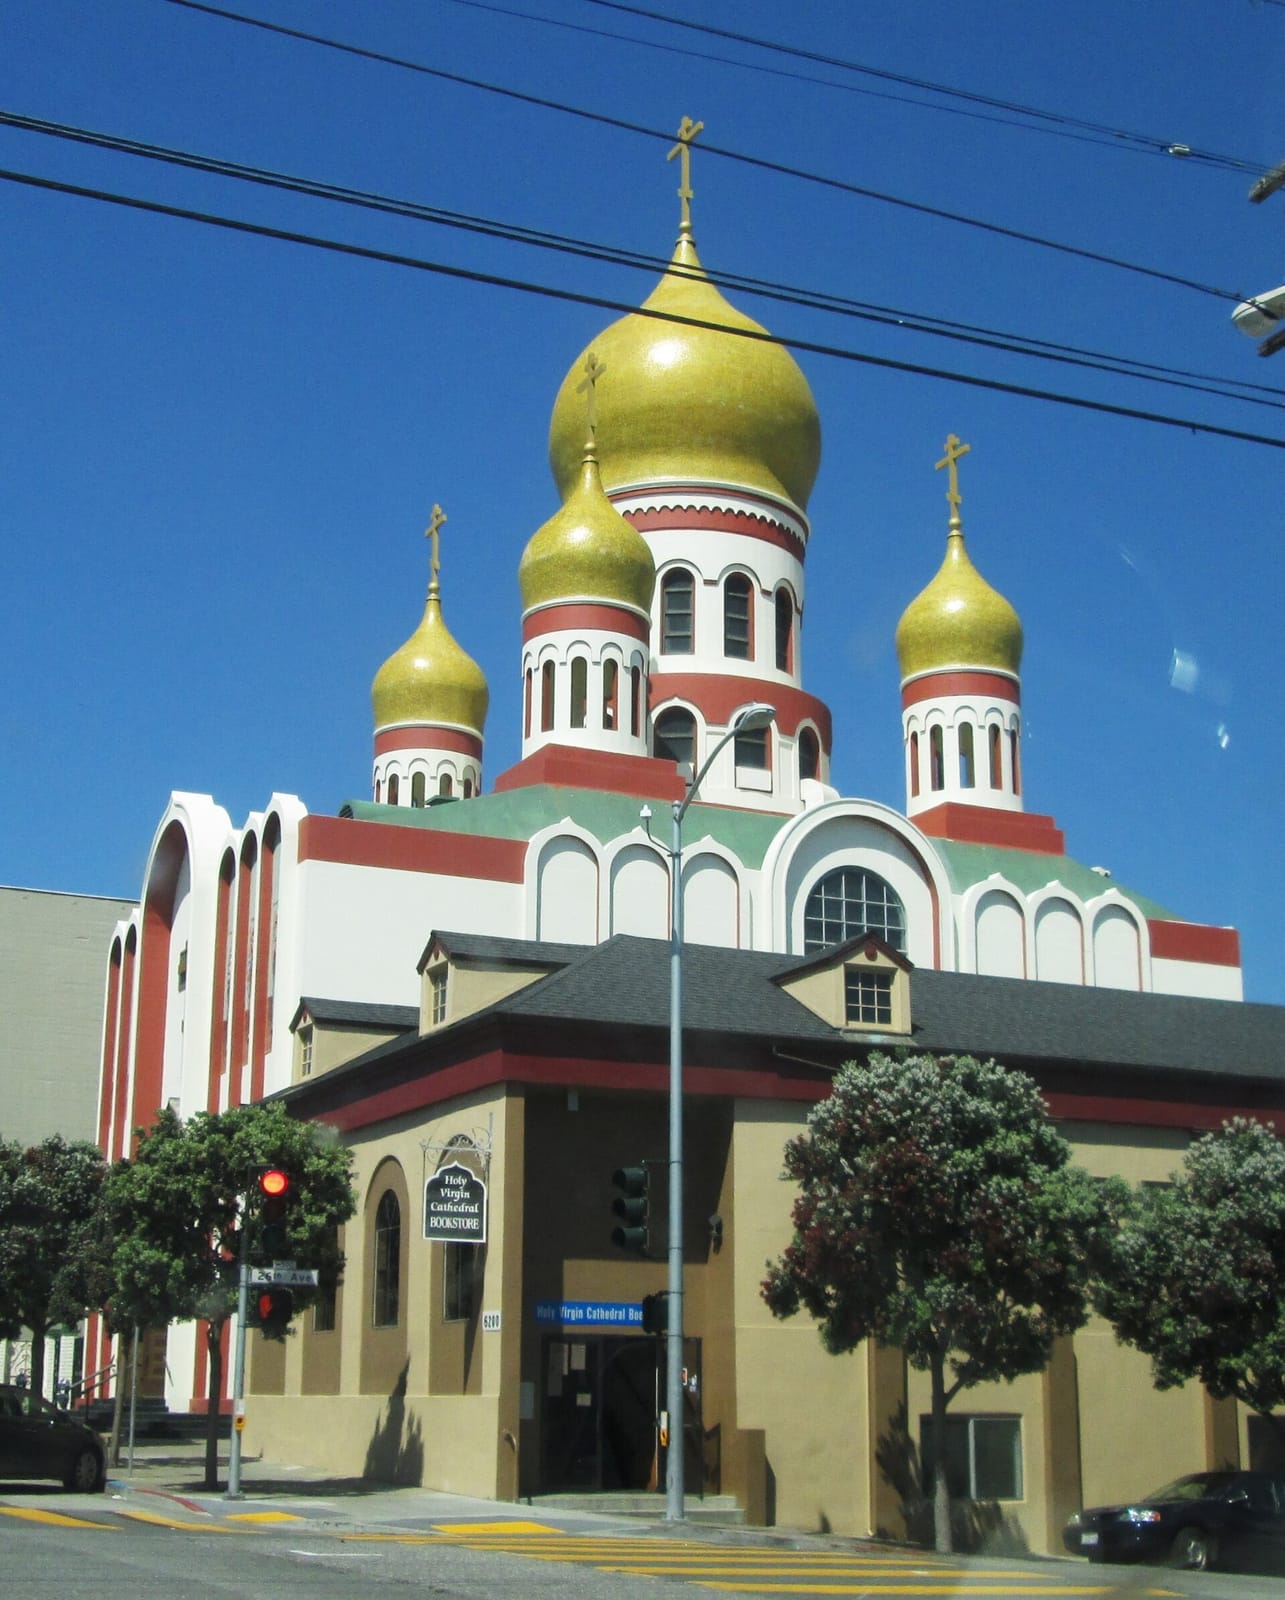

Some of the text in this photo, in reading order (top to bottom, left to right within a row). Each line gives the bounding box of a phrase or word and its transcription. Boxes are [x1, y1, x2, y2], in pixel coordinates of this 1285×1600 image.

[445, 1175, 467, 1189] Holy
[440, 1188, 470, 1202] Virgin
[430, 1202, 480, 1213] Cathedral
[430, 1216, 480, 1230] BOOKSTORE
[290, 1273, 313, 1282] Ave
[560, 1304, 584, 1321] Virgin
[586, 1306, 626, 1321] Cathedral
[628, 1308, 644, 1321] Boo
